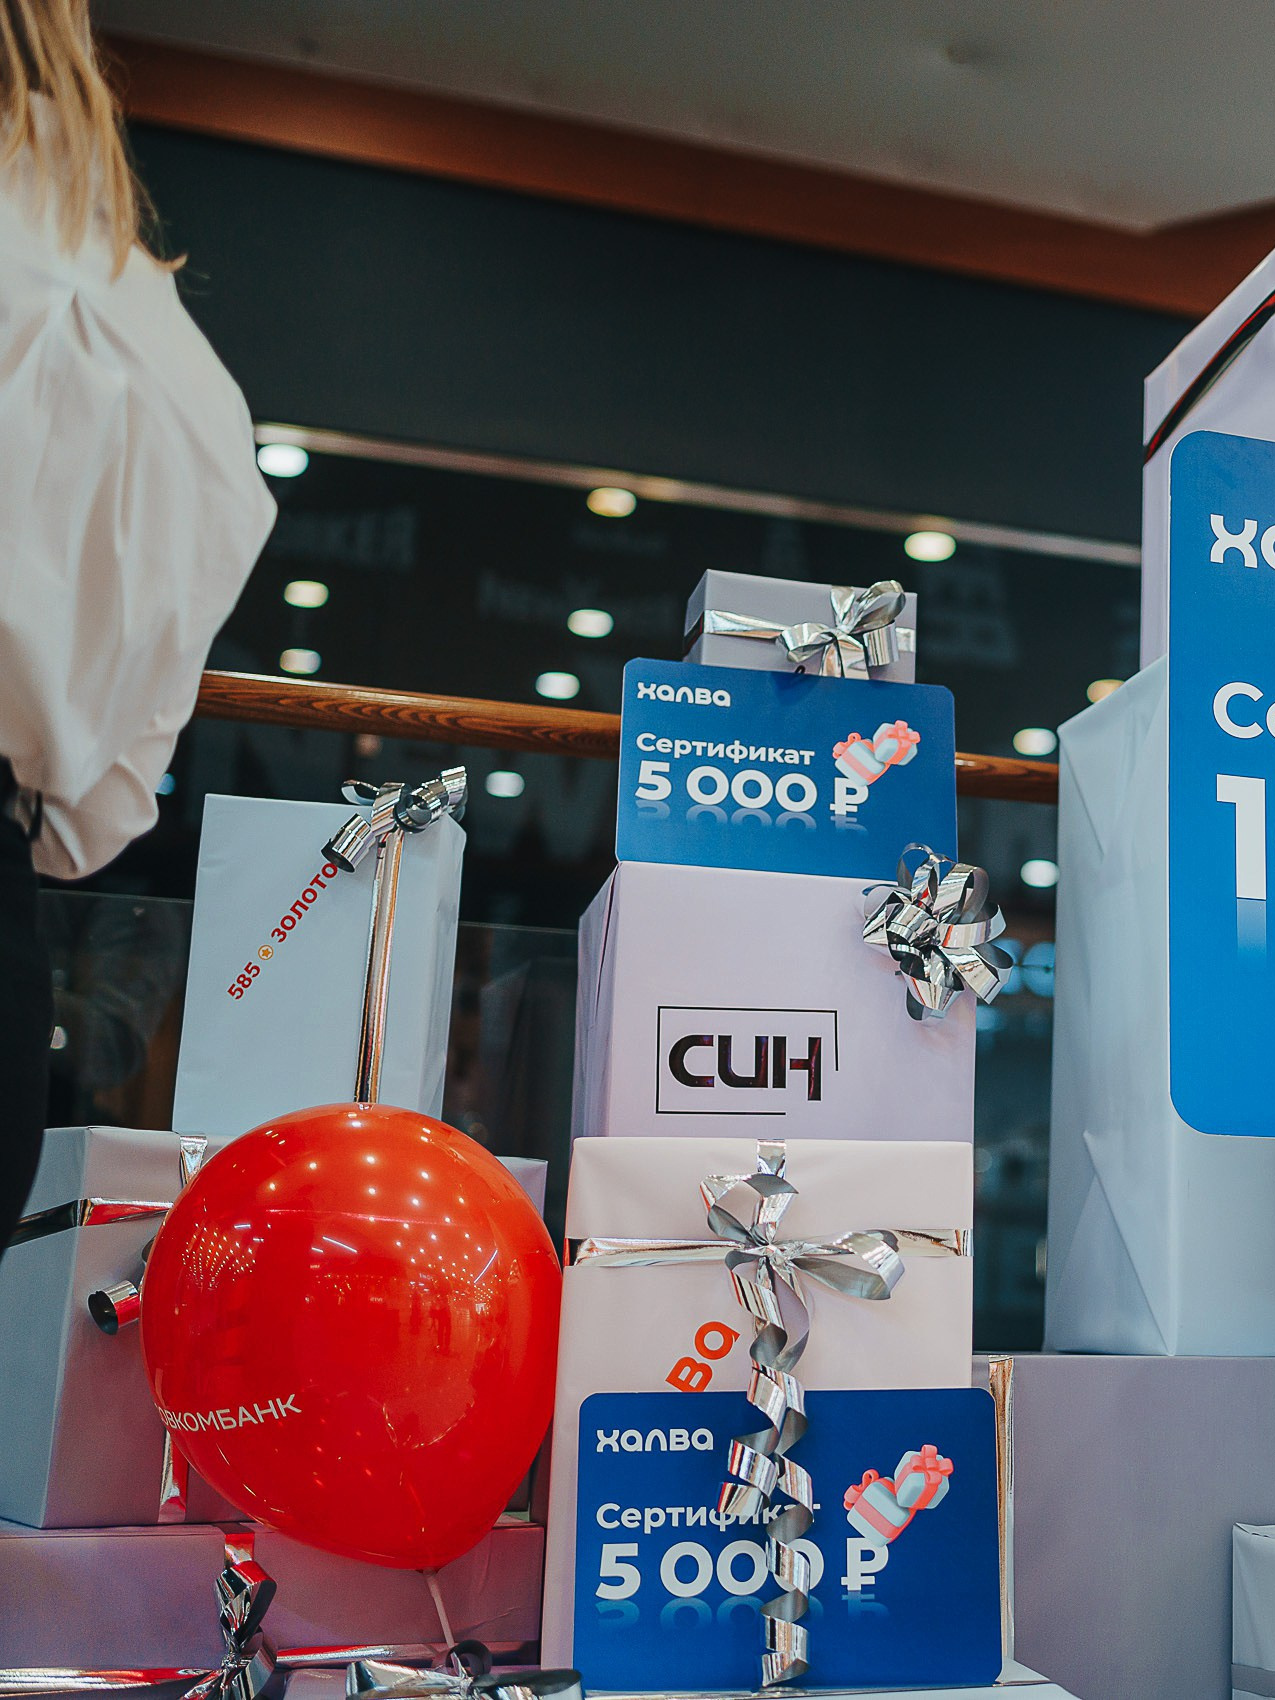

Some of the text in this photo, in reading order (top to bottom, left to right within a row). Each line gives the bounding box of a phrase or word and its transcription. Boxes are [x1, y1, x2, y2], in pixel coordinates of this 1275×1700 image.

[636, 732, 815, 766] Сертификат
[227, 962, 261, 1000] 585
[154, 1393, 302, 1432] ОВКОМБАНК
